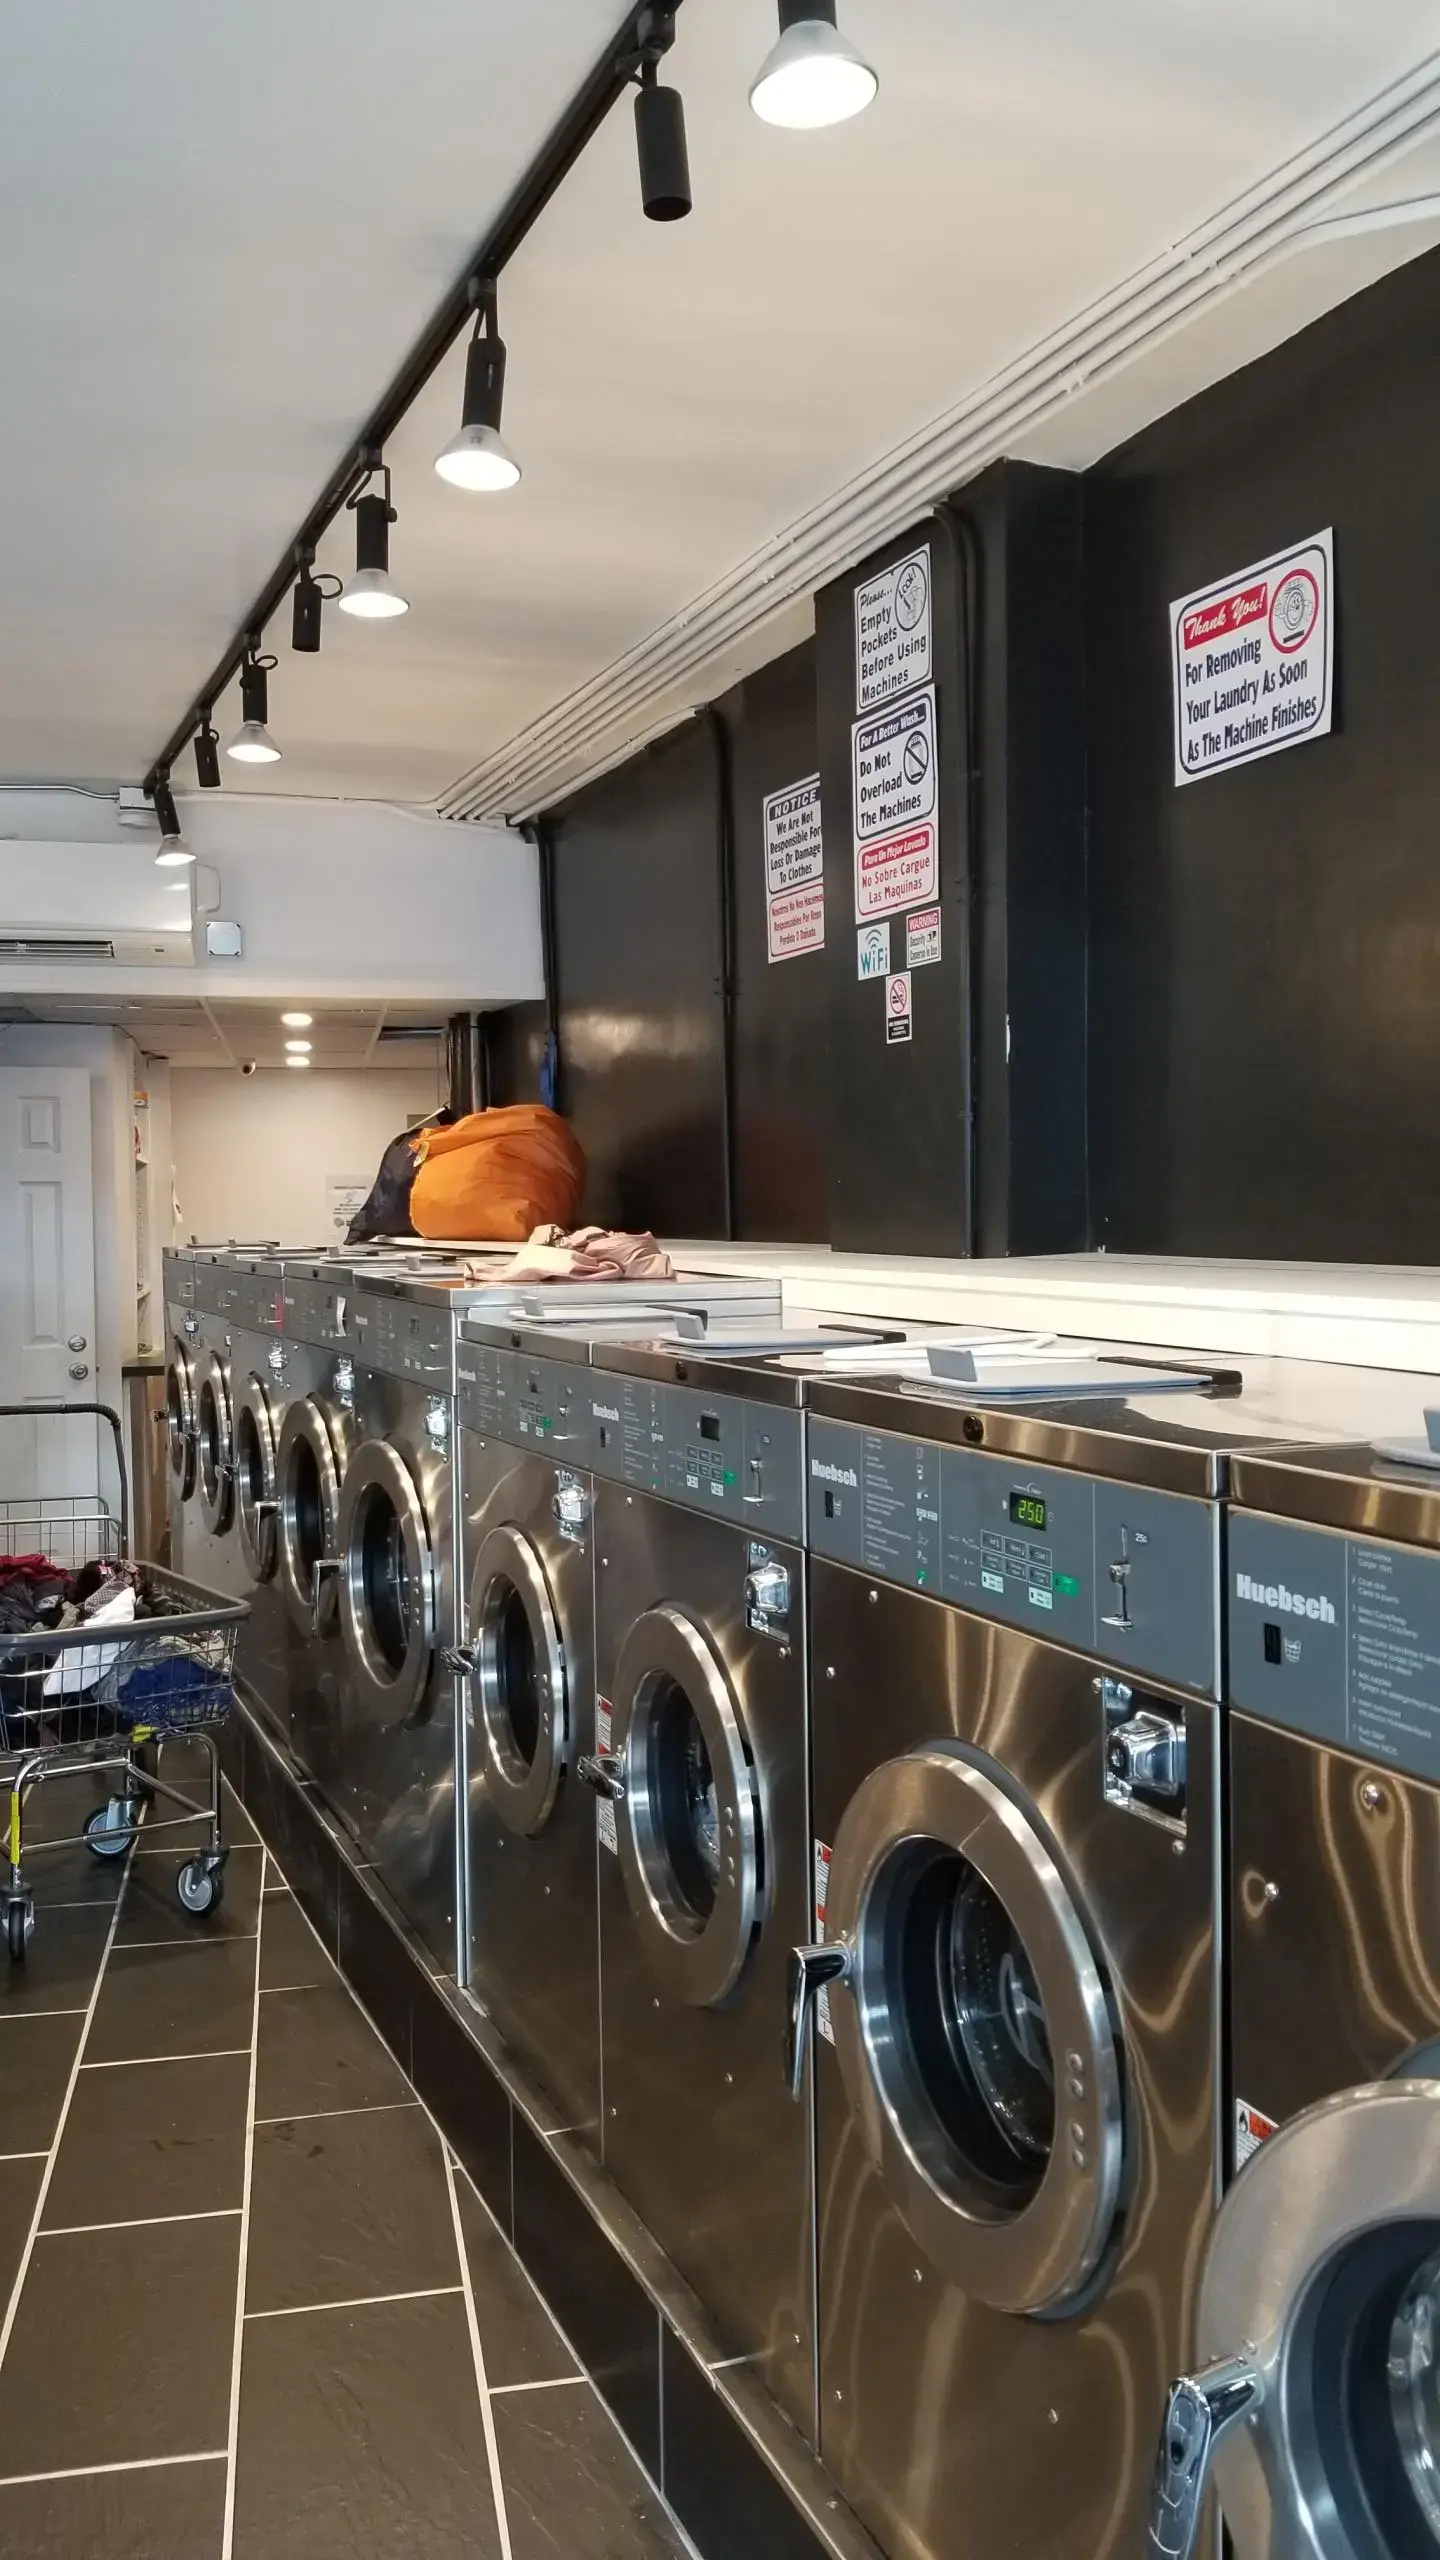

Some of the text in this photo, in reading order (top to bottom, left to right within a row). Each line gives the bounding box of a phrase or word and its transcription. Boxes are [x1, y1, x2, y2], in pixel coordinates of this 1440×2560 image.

[861, 606, 892, 634] Empty
[1185, 585, 1265, 641] Thank You!
[861, 627, 897, 658] Pockets
[862, 635, 926, 680] Before Using
[1185, 638, 1261, 687] For Removing
[862, 669, 909, 703] Machines
[1186, 658, 1307, 725] Your Laundry As Soon
[860, 735, 872, 749] For
[872, 731, 879, 744] A
[879, 721, 899, 740] Better
[1187, 696, 1316, 764] As The Machine Finishes
[860, 751, 891, 778] Do Not
[861, 771, 902, 803] Overload
[774, 789, 817, 818] NOTICE
[861, 794, 921, 829] The Machines
[777, 811, 813, 835] We Are Not
[770, 826, 821, 855] Responsible For
[770, 843, 821, 871] Loss Or Damage
[780, 864, 812, 884] To Clothes
[862, 856, 930, 889] No Sobre Cargue
[869, 878, 922, 904] Las Maquinas
[909, 913, 938, 931] WARNING
[861, 947, 888, 975] WiFi
[811, 1459, 857, 1487] Huebsch
[1018, 1500, 1044, 1524] 250
[1236, 1573, 1336, 1624] Huebsch
